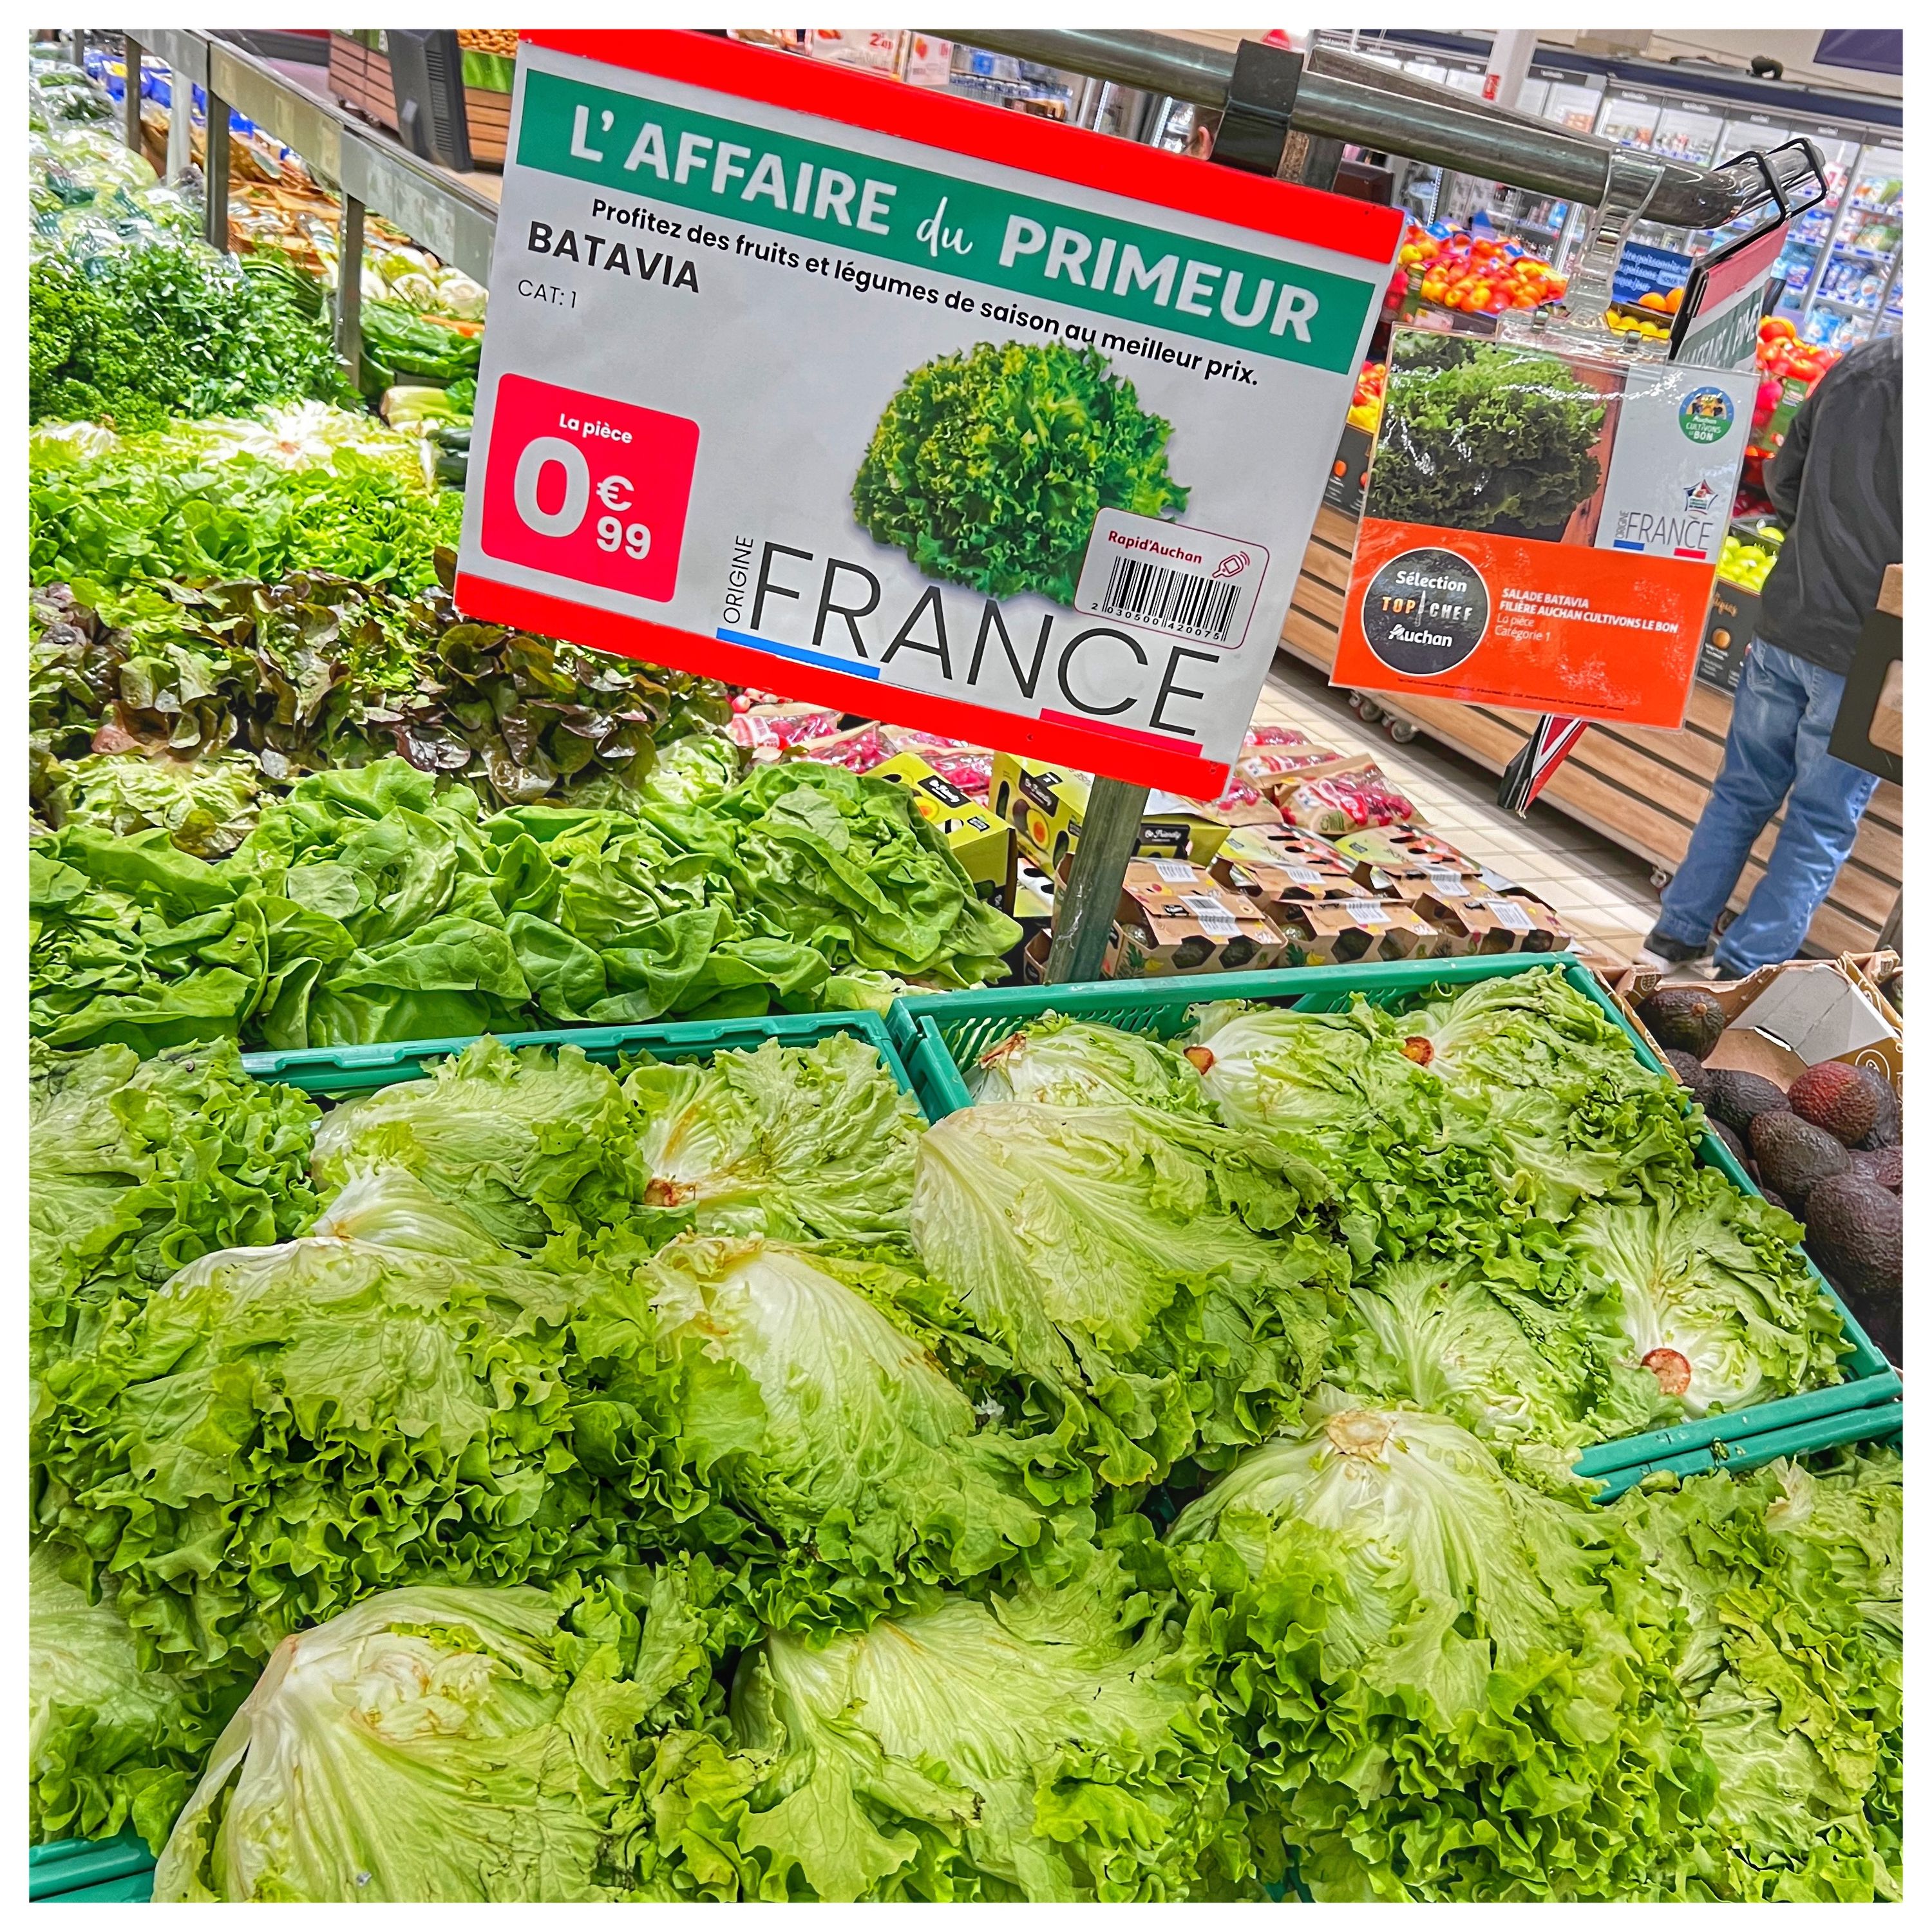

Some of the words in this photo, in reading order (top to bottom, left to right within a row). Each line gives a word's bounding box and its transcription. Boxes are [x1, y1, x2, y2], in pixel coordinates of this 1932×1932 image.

[527, 220, 700, 294] BATAVIA
[916, 196, 973, 258] du
[998, 214, 1320, 343] PRIMEUR
[592, 198, 682, 239] Profitez
[687, 225, 730, 251] des
[735, 235, 799, 269] fruits
[805, 256, 829, 276] et
[834, 260, 939, 305] légumes
[945, 289, 975, 314] de
[980, 303, 1060, 335] saison
[1065, 323, 1096, 345] au
[1101, 333, 1202, 374] meilleur
[1204, 356, 1258, 386] prix.
[559, 413, 579, 430] La
[582, 421, 633, 444] pièce
[1694, 430, 1714, 441] BON
[596, 516, 652, 560] 99
[1615, 510, 1629, 540] ORIGINE
[1625, 512, 1714, 551] FRANCE
[1108, 530, 1202, 564] Rapid'Auchan
[723, 535, 753, 624] ORIGINE
[1396, 571, 1467, 592] Sélection
[1382, 596, 1416, 614] TOP
[1429, 602, 1473, 621] CHEF
[1501, 587, 1544, 602] SALADE
[1546, 593, 1589, 609] BATAVIA
[1497, 613, 1508, 624] La
[1510, 614, 1535, 627] pièce
[1499, 600, 1537, 614] FILIÈRE
[1537, 605, 1582, 621] AUCHAN
[1583, 611, 1641, 629] CULTIVONS
[1642, 620, 1654, 630] LE
[1655, 621, 1678, 633] BON
[750, 541, 1220, 737] FRANCE
[1388, 623, 1452, 647] Auchan
[1495, 625, 1543, 641] Catégorie
[1546, 632, 1551, 641] 1
